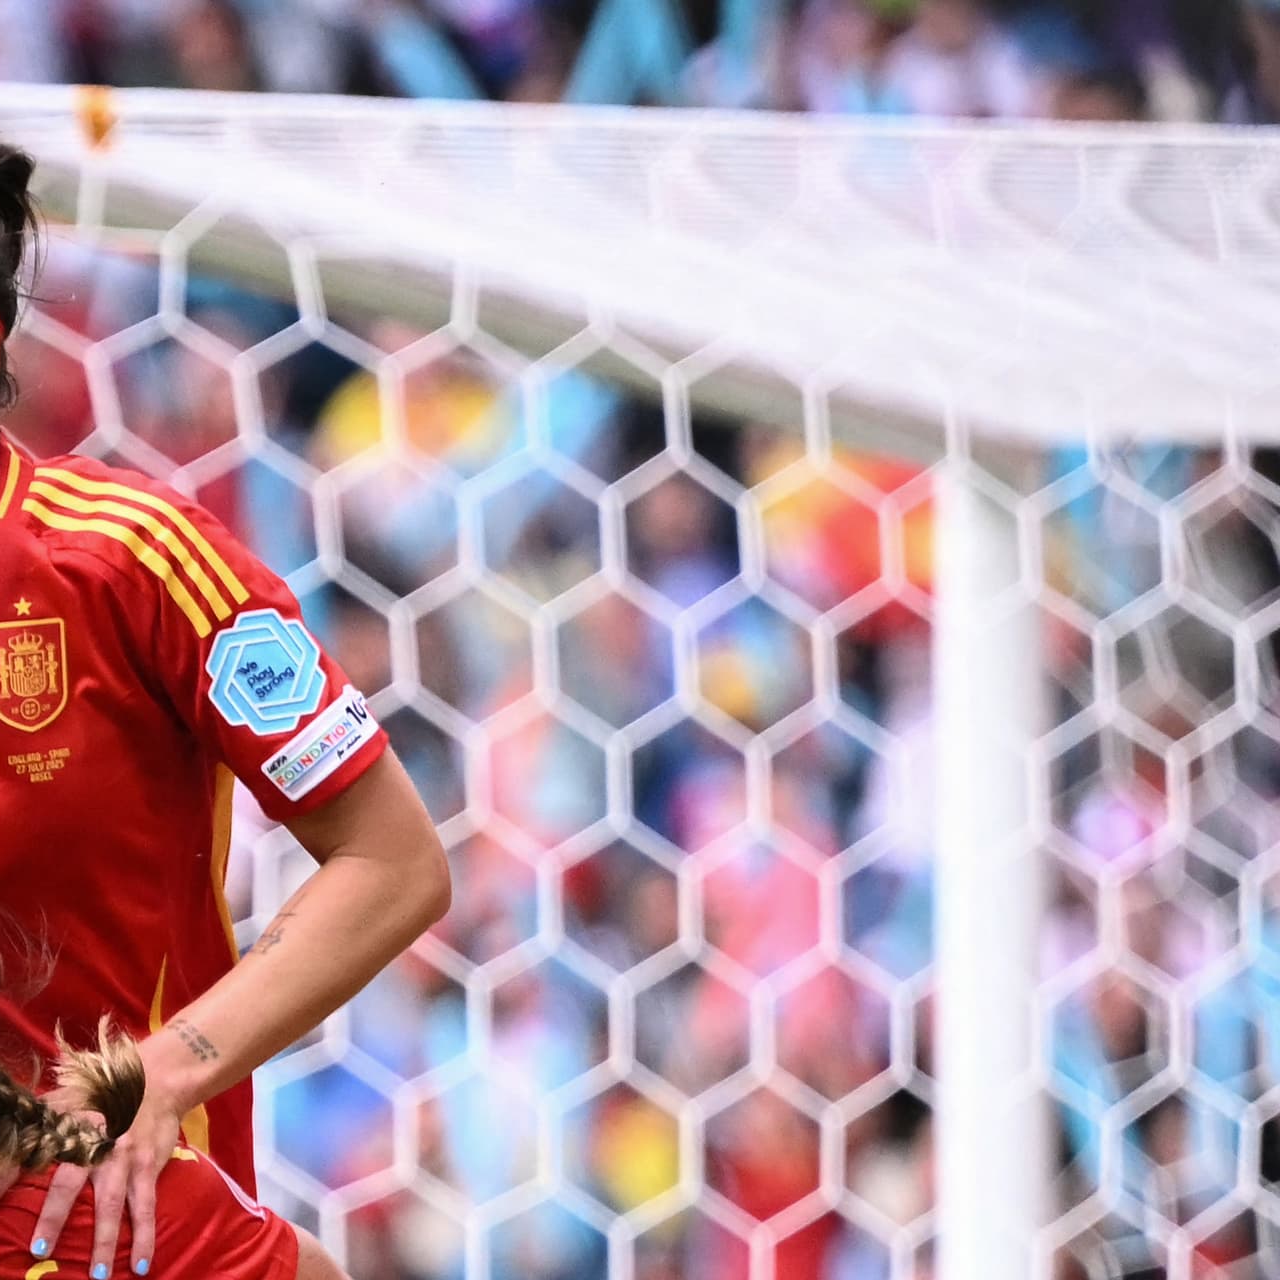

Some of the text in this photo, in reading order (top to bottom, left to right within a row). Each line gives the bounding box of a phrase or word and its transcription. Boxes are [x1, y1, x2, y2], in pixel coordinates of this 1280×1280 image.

[255, 666, 296, 699] Strong
[267, 755, 287, 775] UEFA
[276, 720, 352, 787] FOUNDATION
